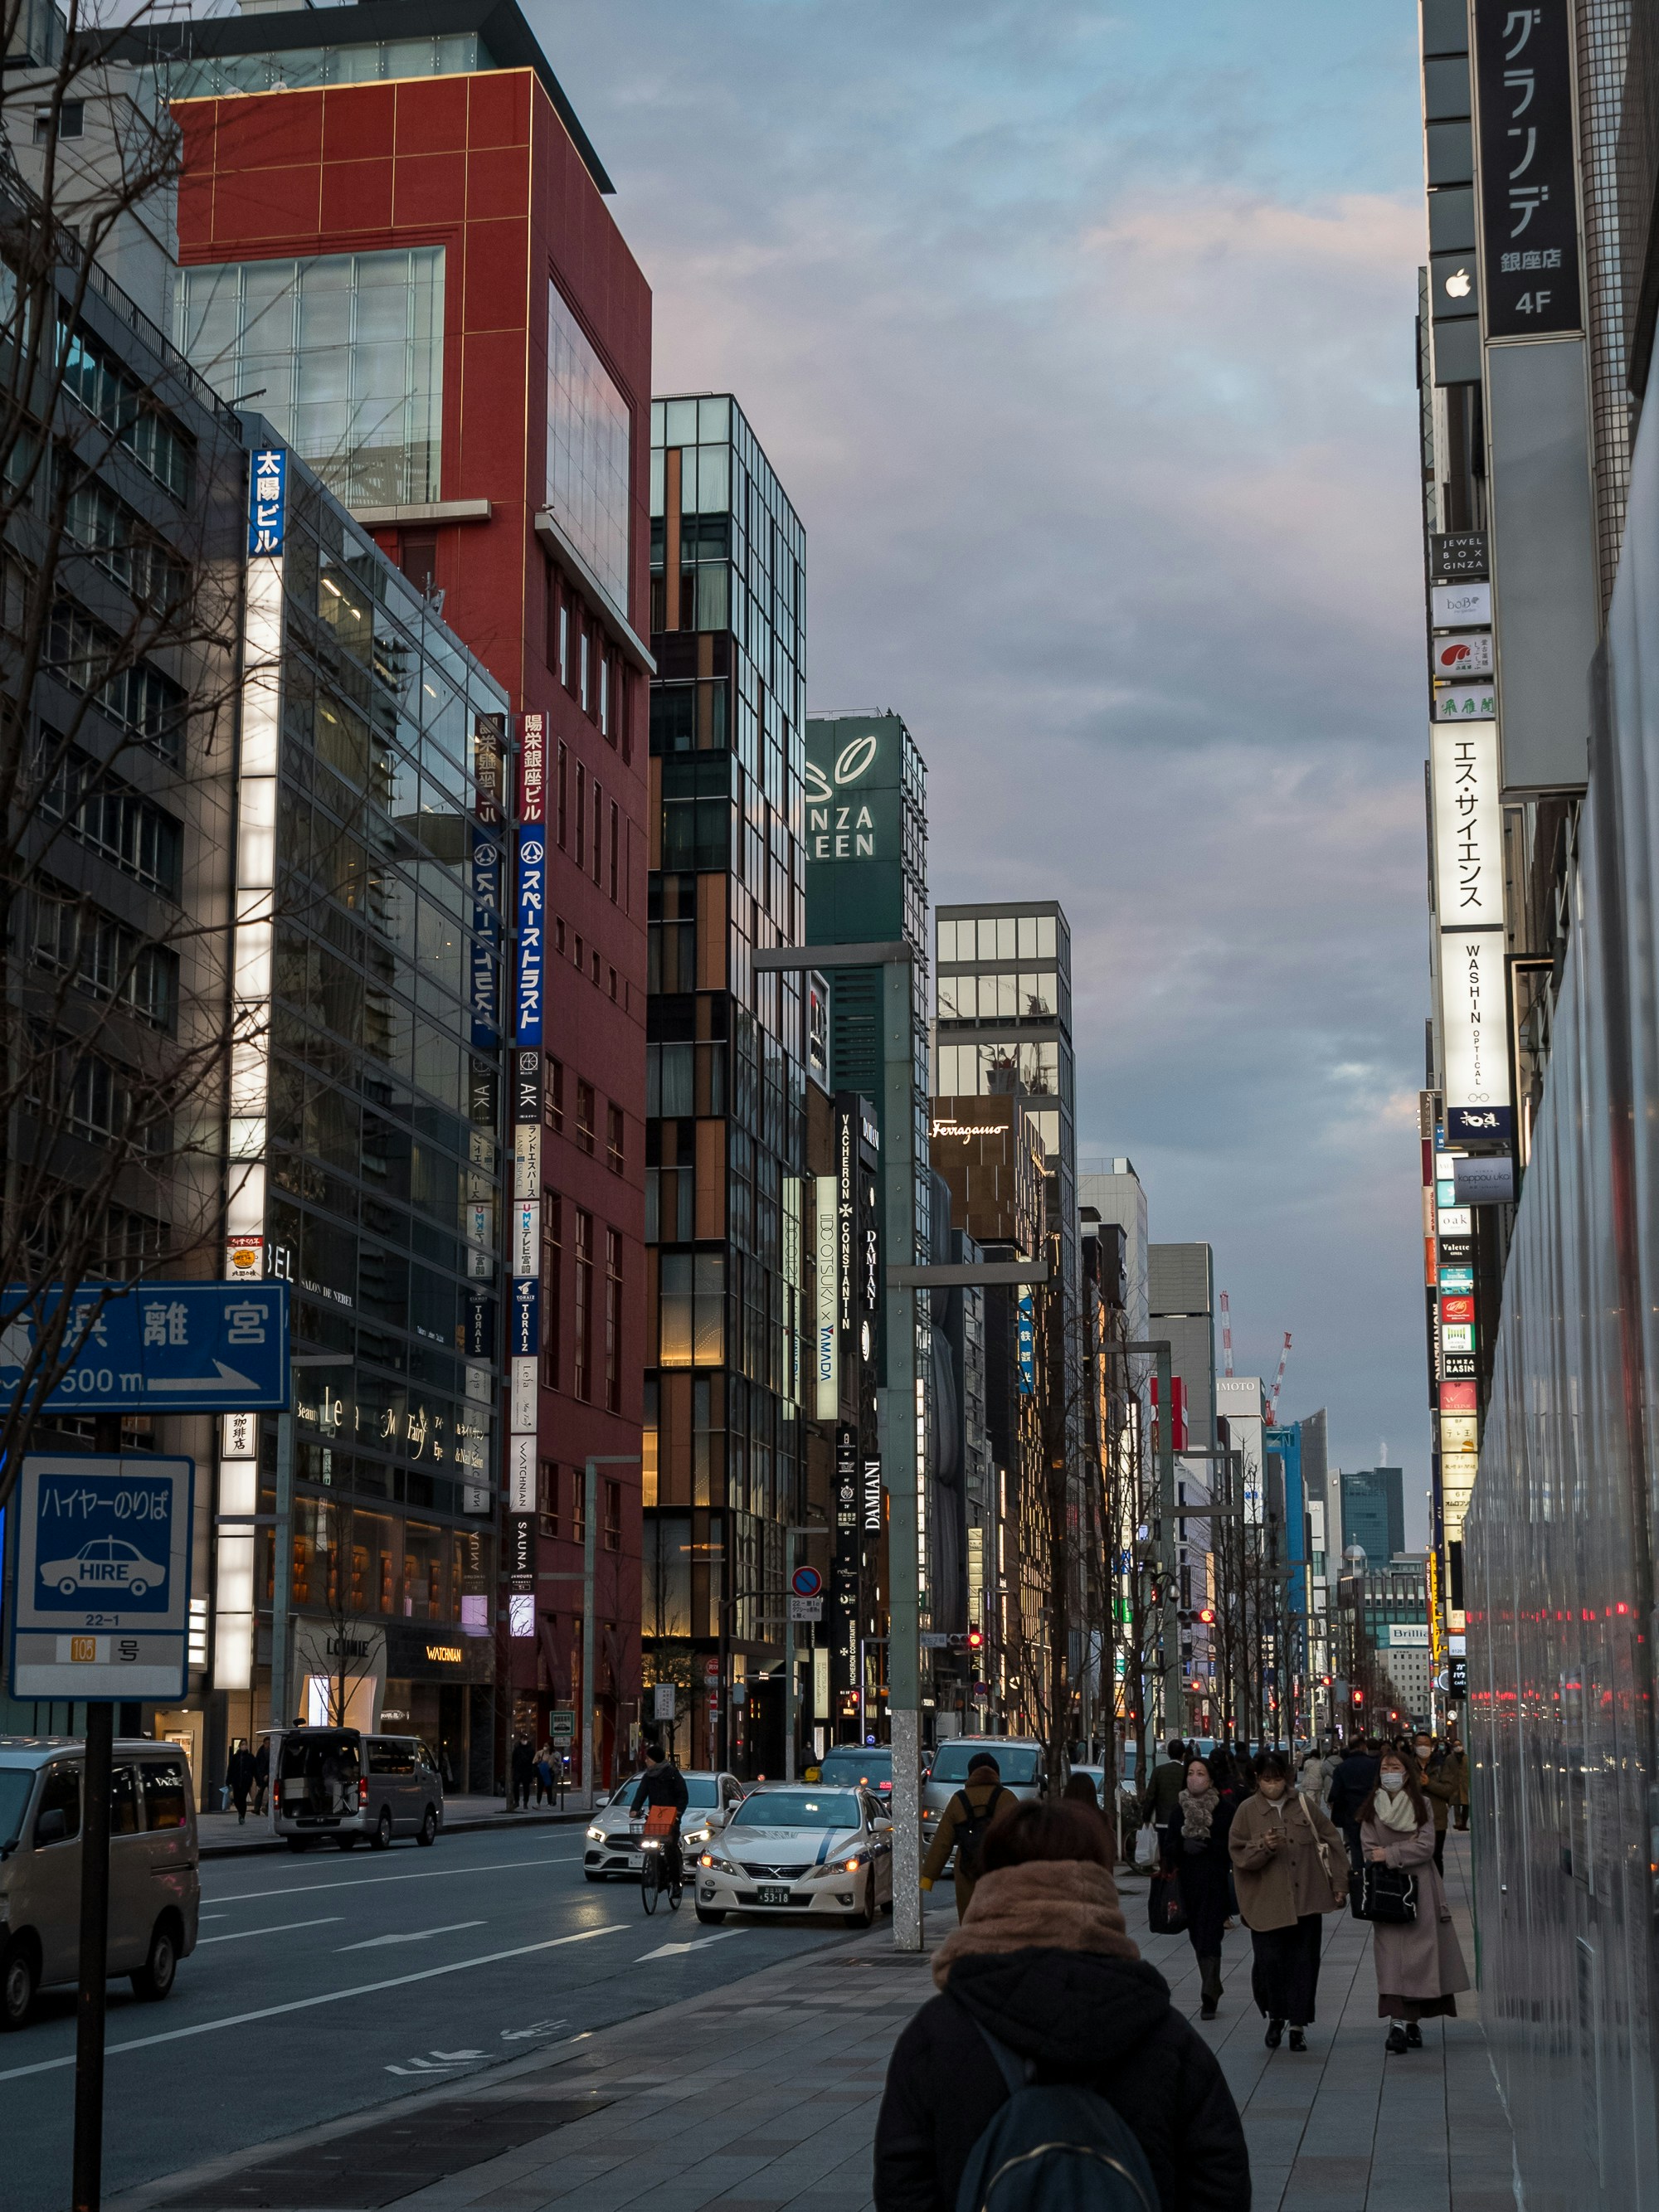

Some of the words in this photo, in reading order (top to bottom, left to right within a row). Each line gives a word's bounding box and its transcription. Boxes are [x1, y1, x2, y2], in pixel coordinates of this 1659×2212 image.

[1502, 9, 1548, 238] グランデ
[1501, 249, 1561, 272] 銀座店
[1515, 291, 1551, 314] 4F
[254, 451, 280, 553] 太陽ビル
[1443, 538, 1482, 548] JEWEL
[1443, 550, 1481, 559] BOX
[1443, 561, 1482, 570] GINZA
[523, 714, 542, 821] 陽栄銀座ビル
[1454, 742, 1482, 907] エス・サイエンス
[805, 834, 873, 861] EEN
[520, 871, 542, 1029] スペーストラスト
[1466, 946, 1481, 1023] WASHIN
[1473, 1030, 1481, 1086] OPTICAL
[520, 1083, 537, 1106] AK
[928, 1119, 1010, 1145] Ferragamo
[842, 1115, 850, 1199] VACHERON
[1458, 1171, 1491, 1184] kappou
[1494, 1172, 1511, 1181] ukai
[820, 1214, 834, 1241] IDC
[1443, 1213, 1467, 1225] oak
[820, 1244, 834, 1308] OTSUKA
[841, 1222, 850, 1330] CONSTANTIN
[866, 1230, 877, 1310] DAMIANI
[300, 1279, 322, 1294] SALON
[323, 1286, 332, 1299] DE
[333, 1291, 353, 1308] NEBEL
[521, 1304, 529, 1352] TORAIZ
[820, 1325, 834, 1382] YAMADA
[61, 1369, 114, 1393] 500
[119, 1373, 144, 1392] m
[1446, 1364, 1476, 1373] RASIN
[232, 1413, 247, 1452] 珈琲店
[42, 1489, 168, 1519] ハイヤーのりば
[865, 1461, 880, 1530] DAMIANI
[518, 1522, 527, 1570] SAUNA
[80, 1563, 129, 1581] HIRE
[85, 1614, 119, 1626] 22-1
[118, 1640, 139, 1661] 号
[426, 1646, 461, 1662] WATCHNIAN
[764, 1894, 788, 1903] 53-18
